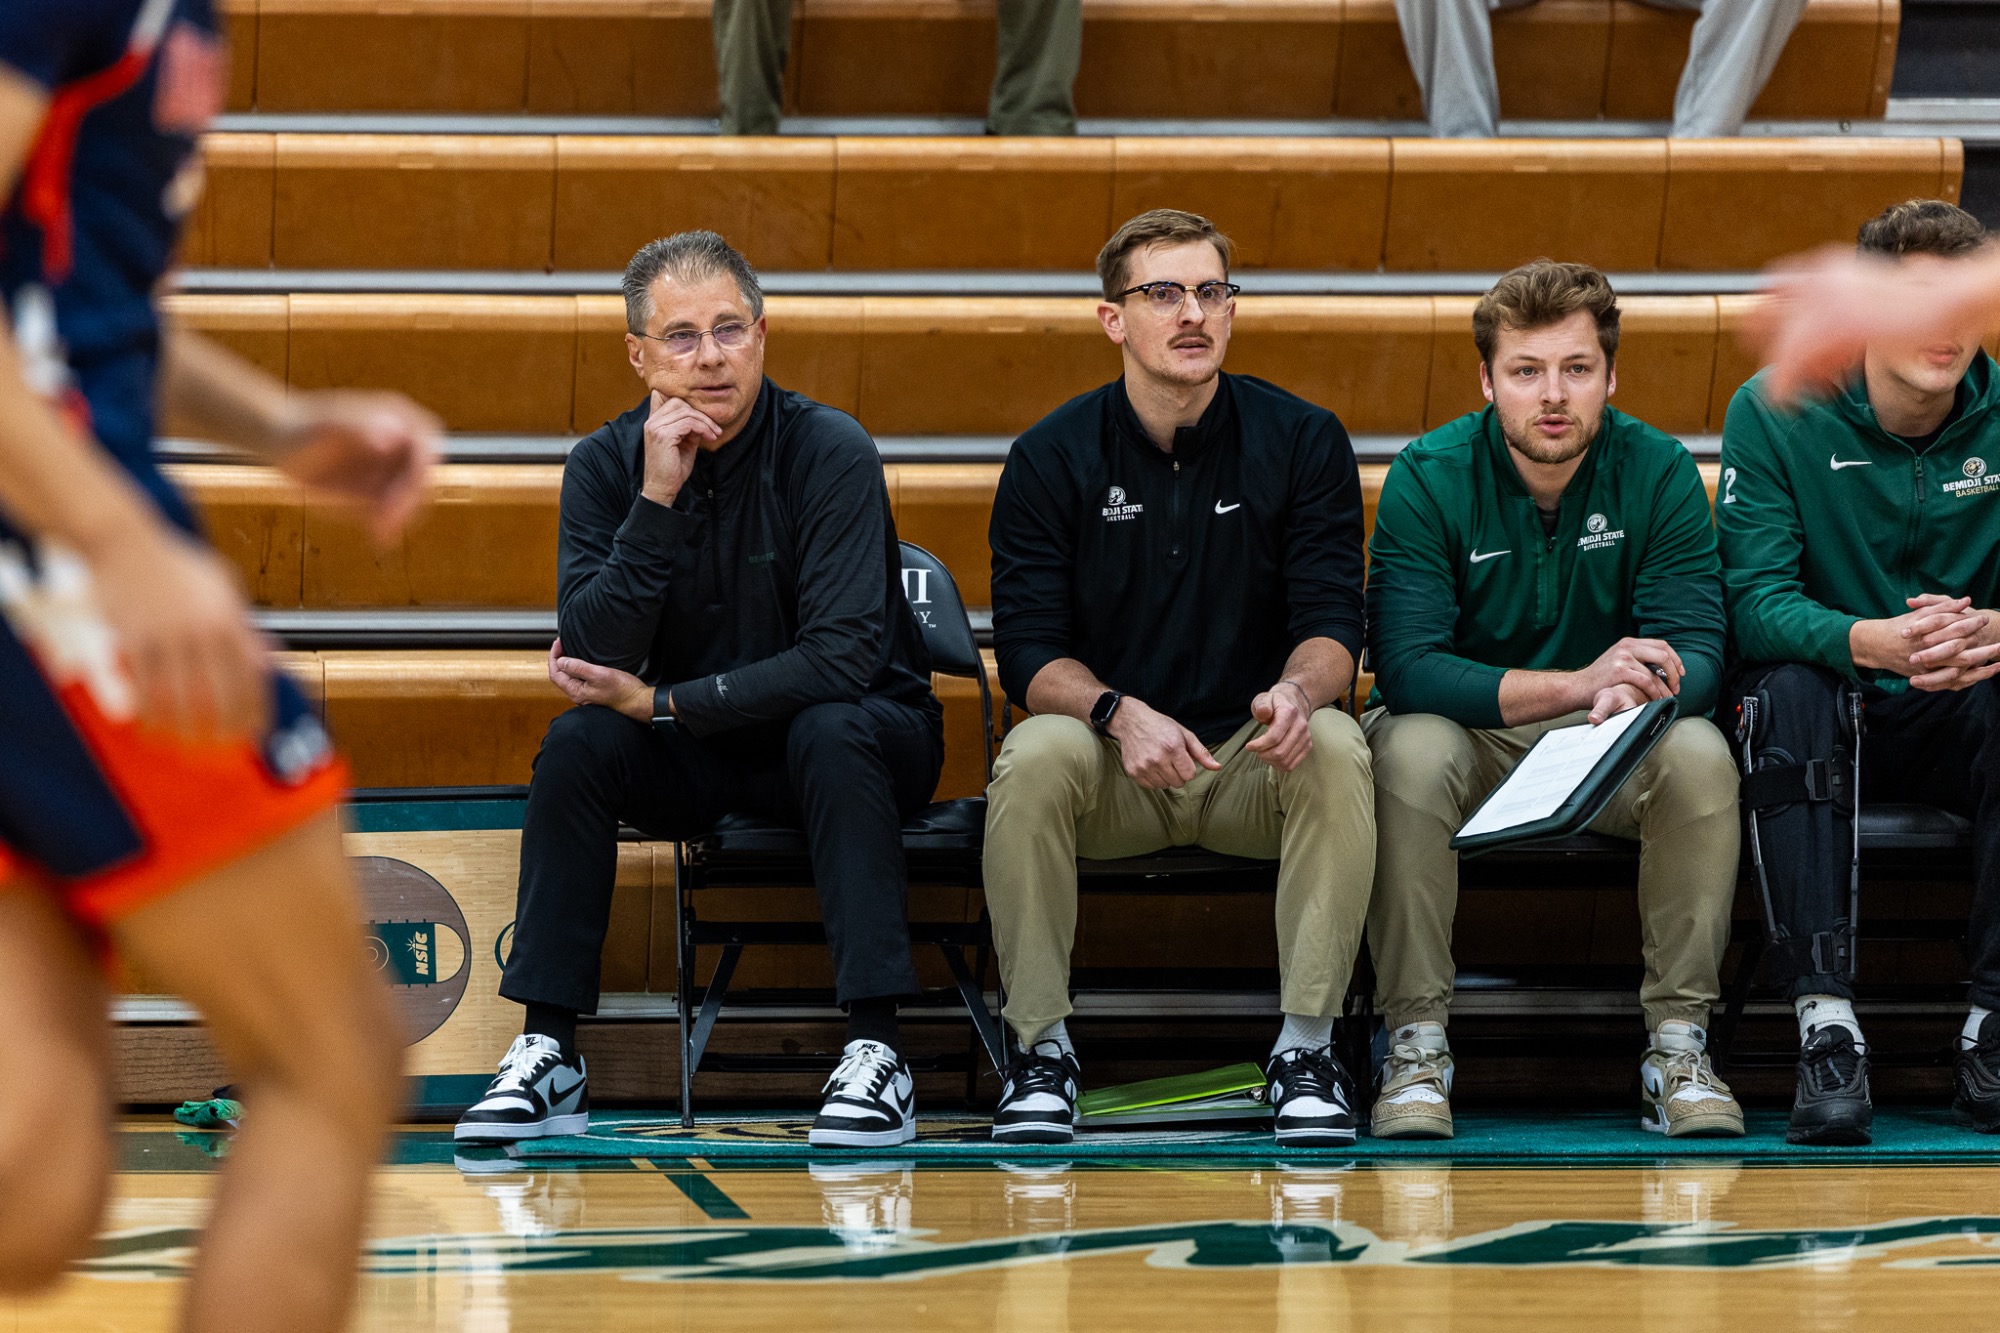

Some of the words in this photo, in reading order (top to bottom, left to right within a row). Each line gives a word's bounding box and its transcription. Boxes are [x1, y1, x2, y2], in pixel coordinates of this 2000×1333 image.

[1723, 467, 1736, 504] 2
[1942, 477, 1982, 493] BEMIDJI
[1983, 473, 2000, 485] STA
[1955, 484, 1999, 498] BASKETBALL
[1602, 530, 1625, 541] STATE
